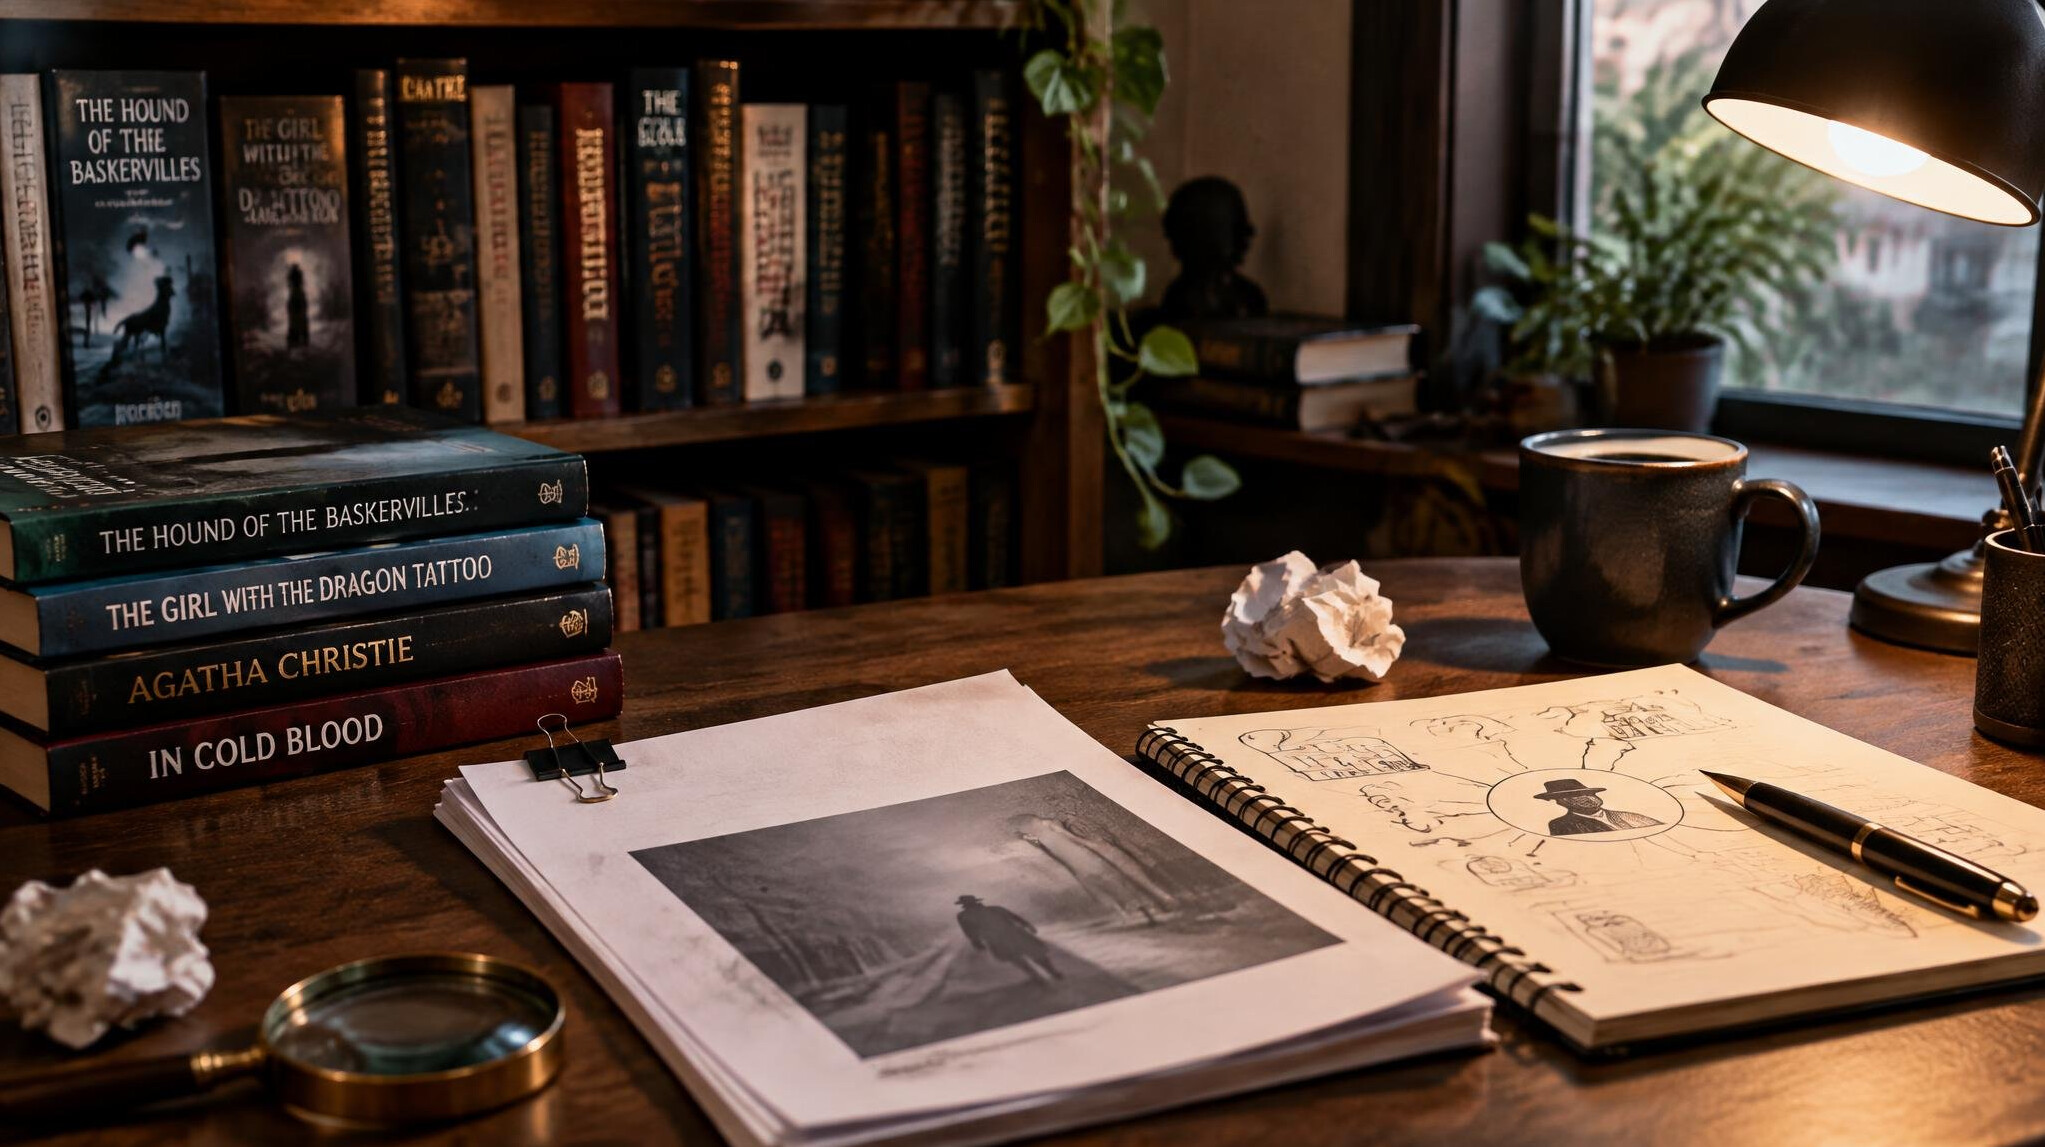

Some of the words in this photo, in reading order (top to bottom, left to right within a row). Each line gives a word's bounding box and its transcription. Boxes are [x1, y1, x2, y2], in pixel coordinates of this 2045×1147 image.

[76, 98, 114, 122] THE
[121, 98, 189, 122] HOUND
[88, 128, 112, 154] OF
[277, 117, 323, 140] GIRL
[70, 157, 201, 184] BASKERVILLES
[100, 527, 145, 553] THE
[153, 518, 235, 549] HOUND
[243, 513, 270, 537] OF
[277, 509, 317, 533] THE
[105, 600, 155, 630] THE
[161, 592, 218, 622] GIRL
[221, 583, 274, 614] WITH
[278, 579, 313, 606] THE
[319, 565, 406, 601] DRAGON
[412, 555, 492, 588] TATTOO
[128, 658, 269, 703] AGATHA
[278, 635, 414, 680] CHRISTIE
[149, 746, 183, 779] IN
[194, 732, 276, 770] COLD
[286, 713, 383, 755] BLOOD
